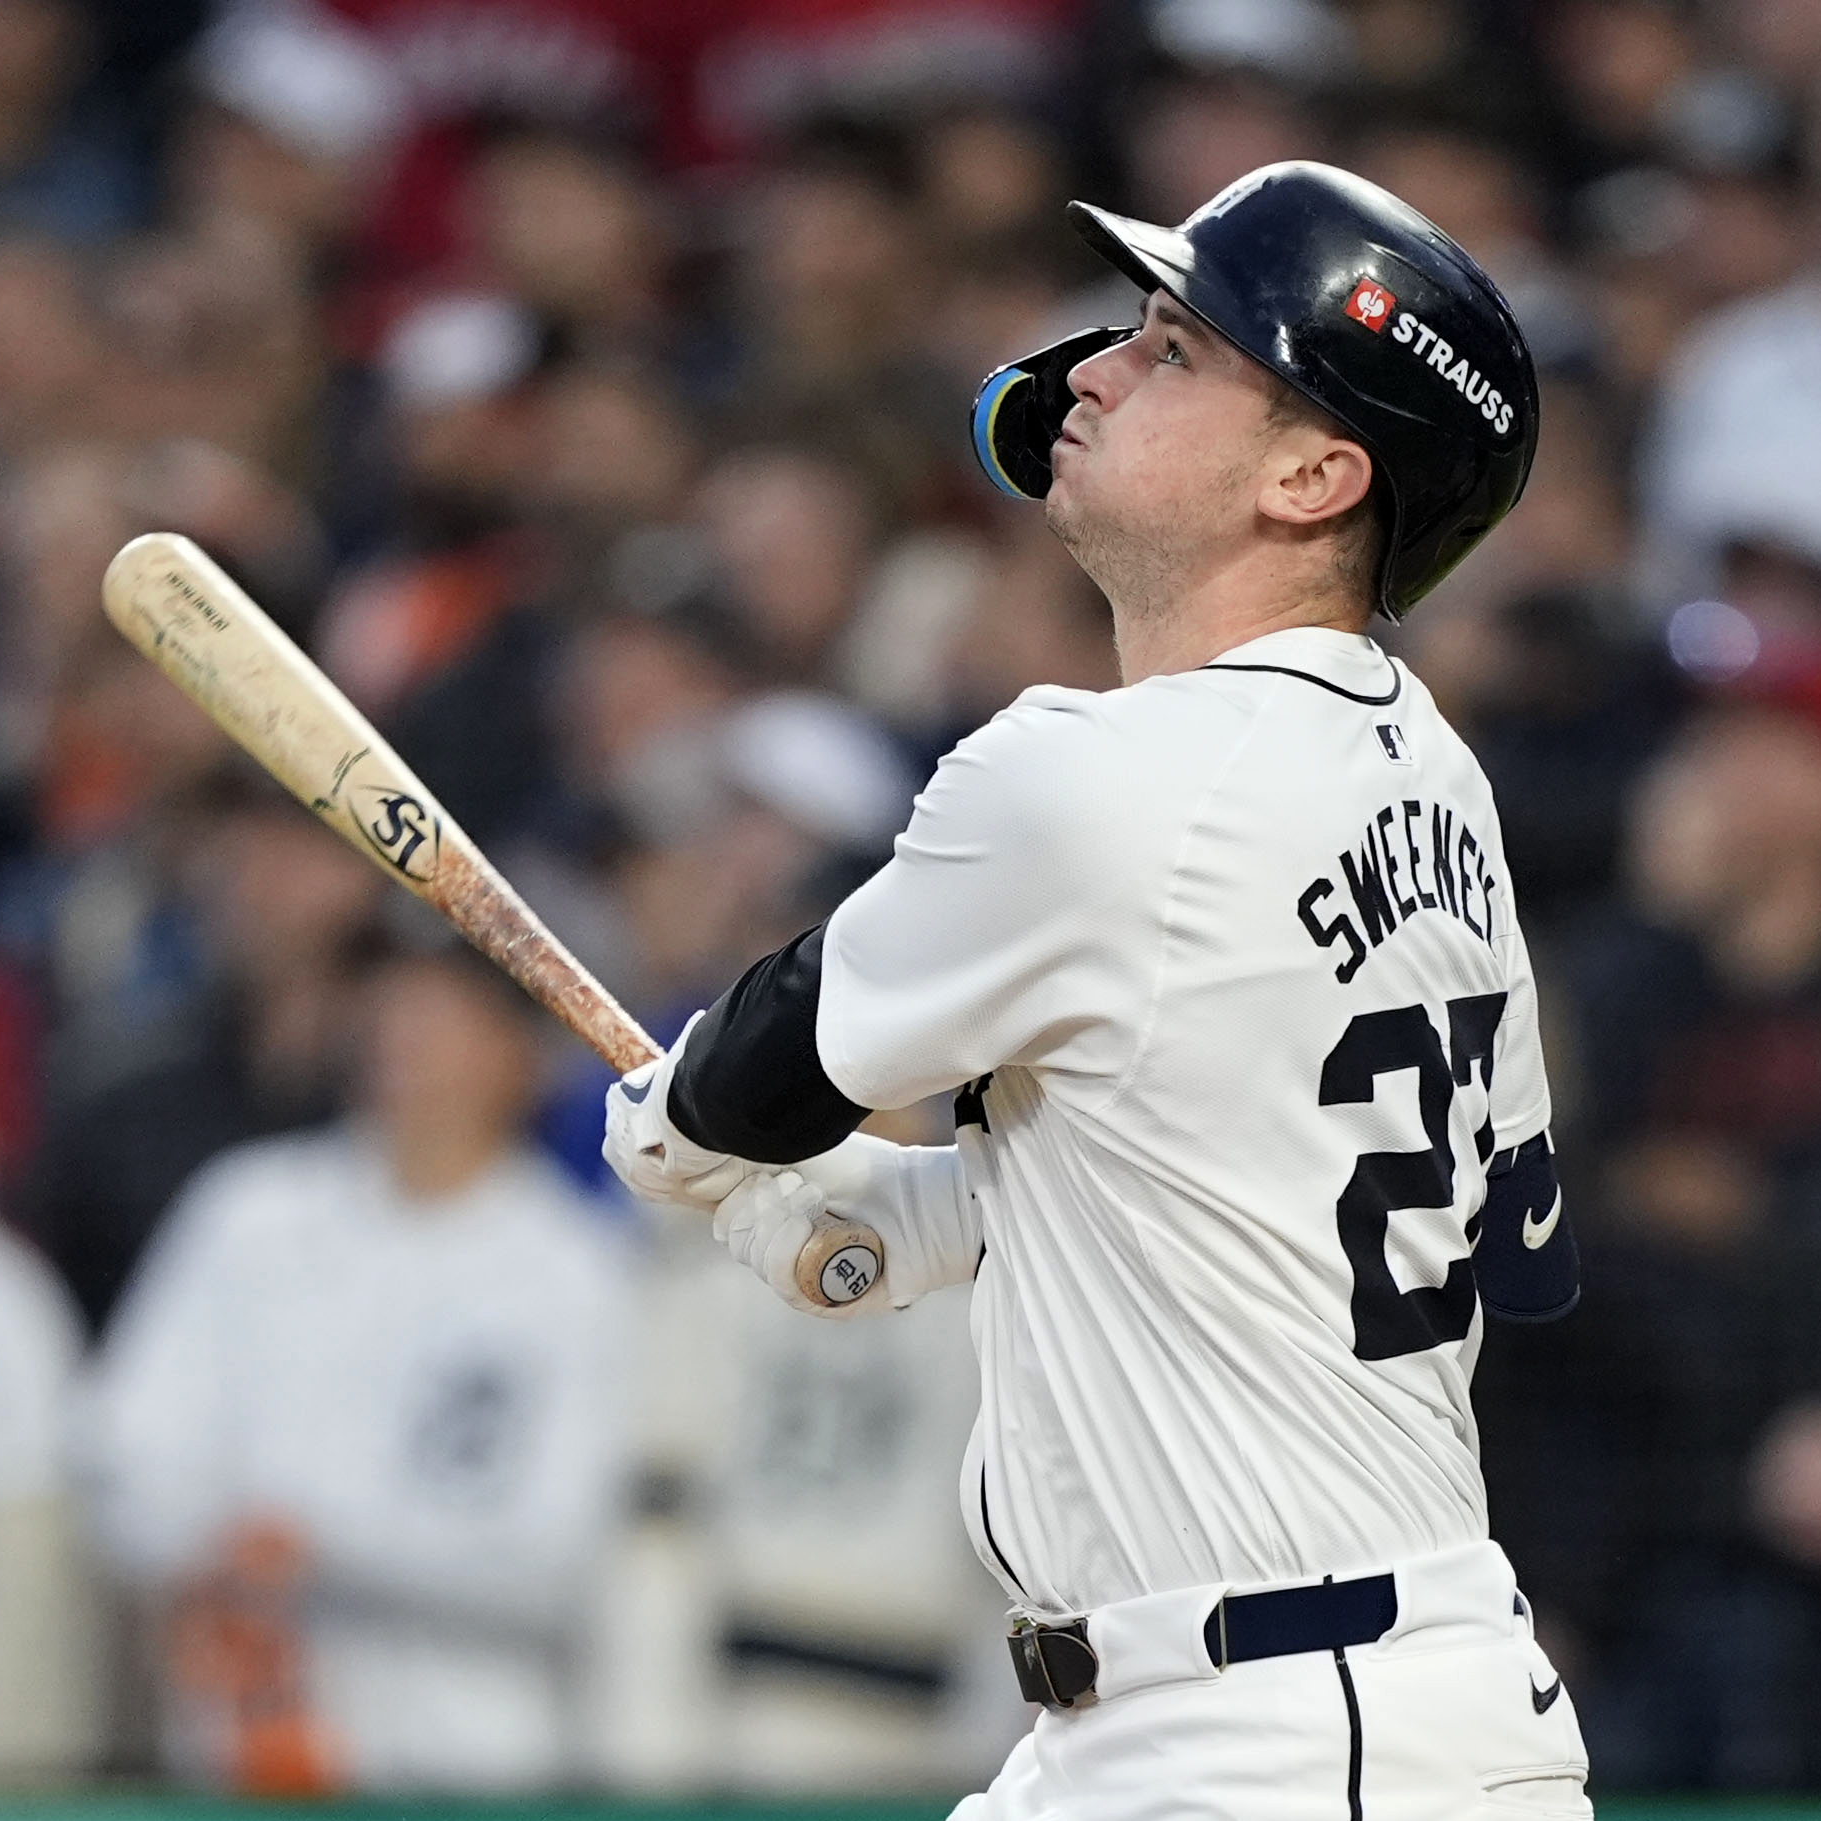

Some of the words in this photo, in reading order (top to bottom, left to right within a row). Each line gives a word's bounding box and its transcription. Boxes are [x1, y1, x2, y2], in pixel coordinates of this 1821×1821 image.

[1391, 311, 1514, 435] STRAUSS
[1297, 799, 1497, 984] SWEENEY
[1318, 991, 1508, 1361] 27
[847, 1271, 870, 1296] 27
